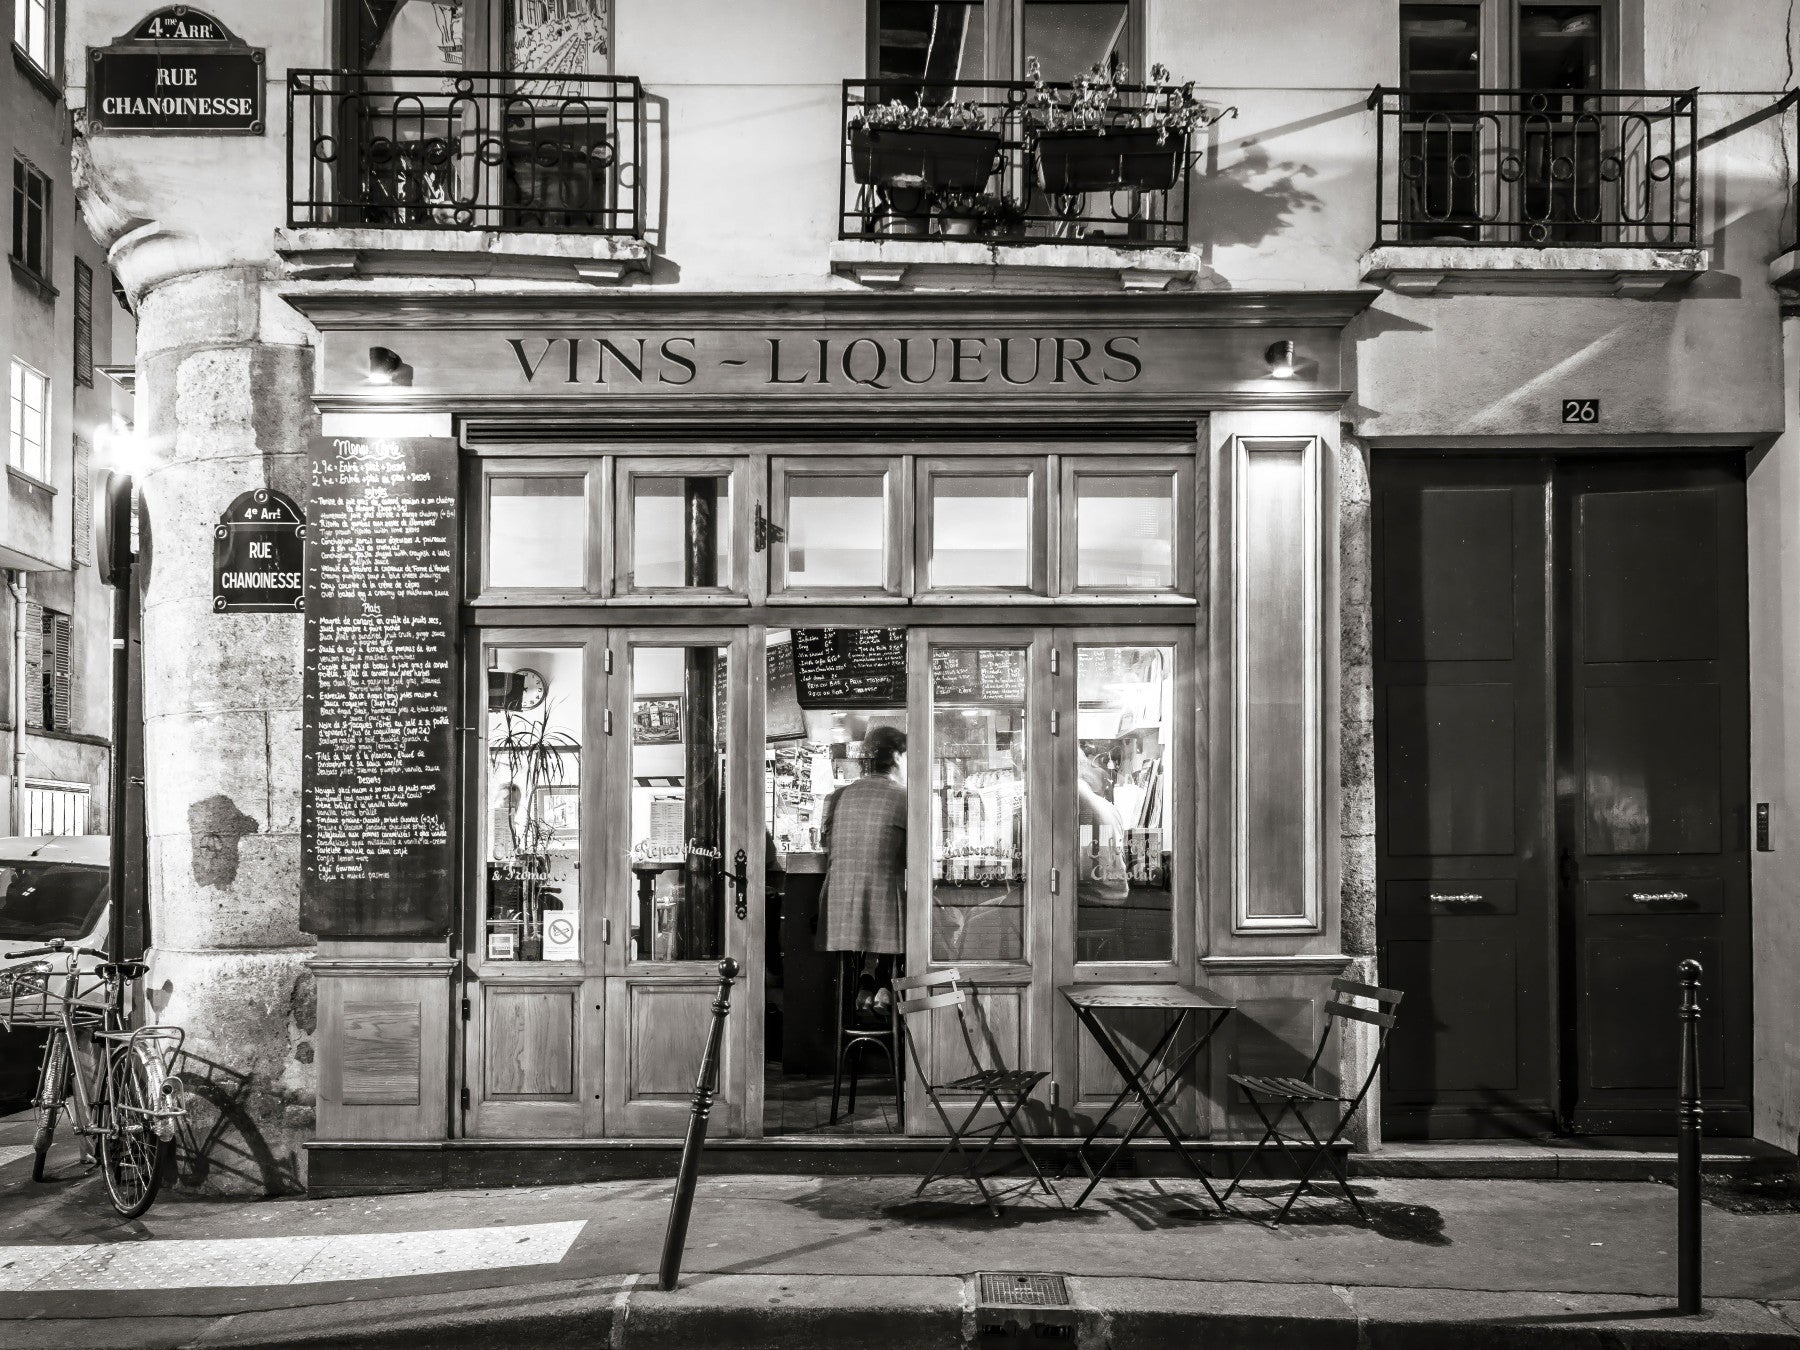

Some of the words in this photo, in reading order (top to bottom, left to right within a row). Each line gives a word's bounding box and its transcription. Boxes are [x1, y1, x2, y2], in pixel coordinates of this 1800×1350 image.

[157, 68, 197, 86] RUE
[102, 97, 252, 115] CHANOINESSE
[506, 337, 697, 385] VINS
[765, 336, 1143, 390] LIQUEURS
[1566, 401, 1595, 421] 26
[249, 541, 272, 559] RUE
[221, 572, 301, 589] CHANOINESSE
[362, 602, 381, 614] Plats
[342, 752, 352, 760] bar
[492, 870, 503, 881] &
